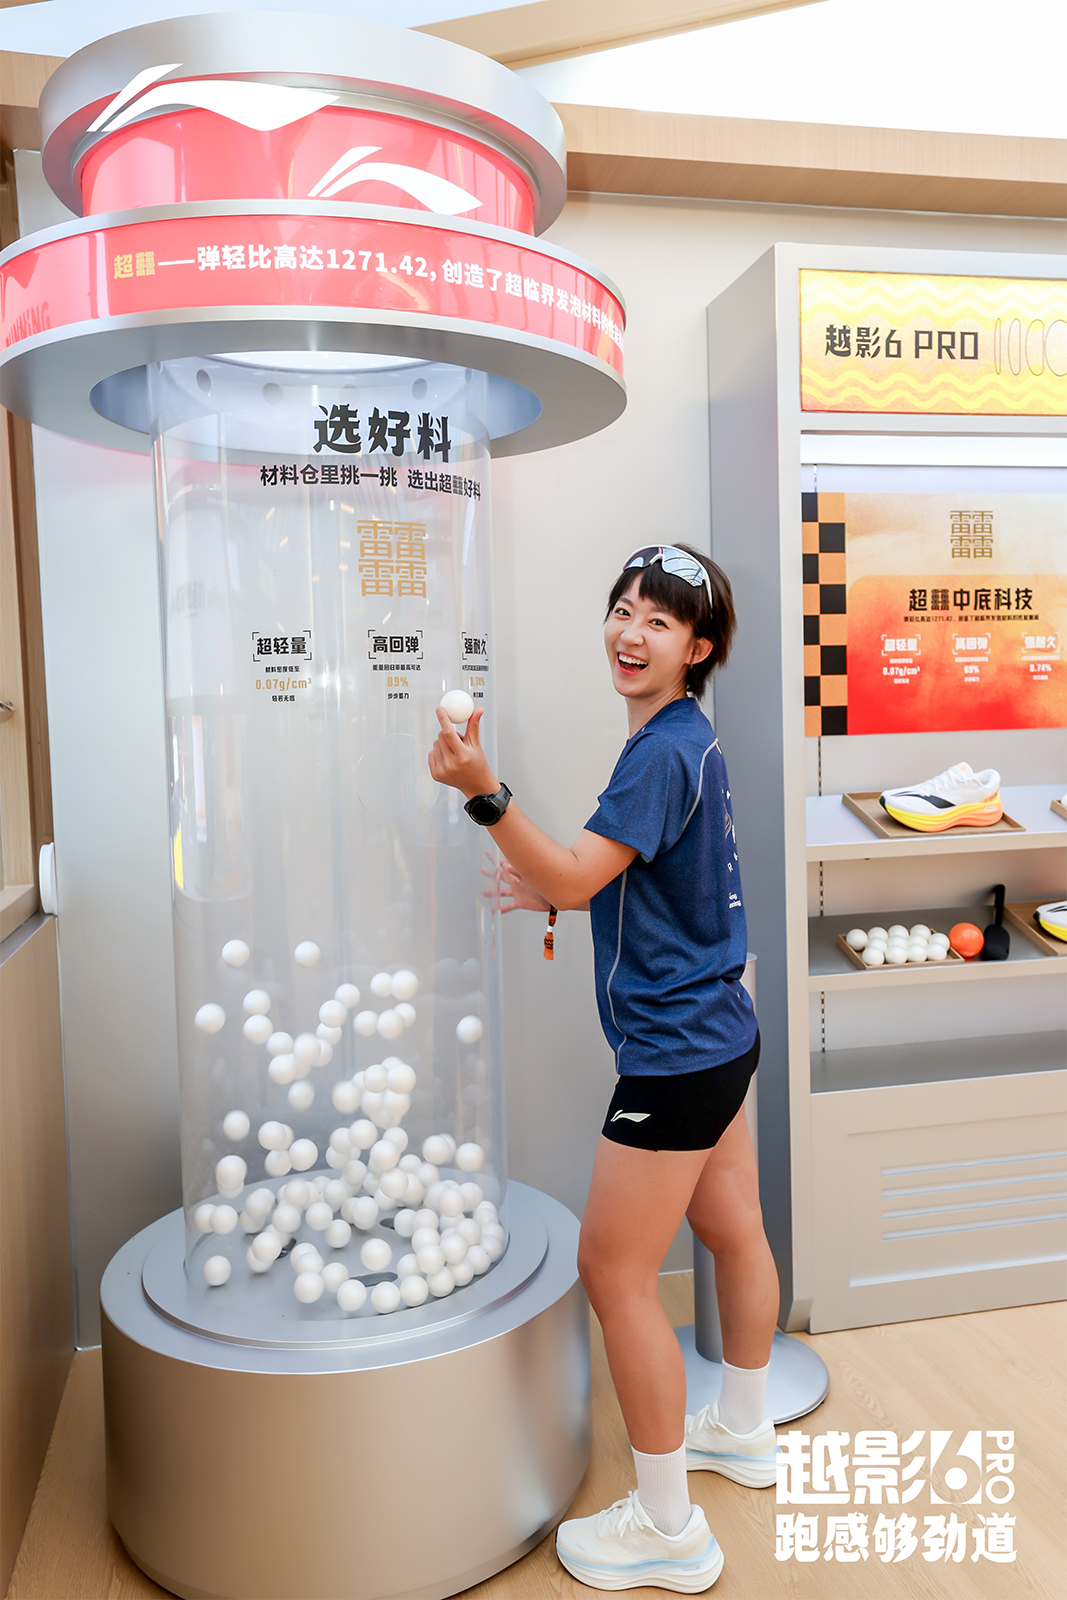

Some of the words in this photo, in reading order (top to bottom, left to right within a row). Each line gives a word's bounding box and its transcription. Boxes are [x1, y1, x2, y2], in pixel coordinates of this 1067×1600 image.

[825, 324, 902, 359] 越影6
[914, 330, 979, 360] PRO
[313, 403, 451, 463] 选好料
[260, 463, 397, 487] 材料仓里挑一挑
[256, 637, 307, 655] 超轻量
[372, 636, 419, 653] 高回弹
[464, 638, 487, 655] 强耐久
[884, 638, 918, 651] 超轻量
[955, 637, 988, 650] 高回弹
[1024, 636, 1056, 649] 强耐久
[387, 676, 409, 688] 89%
